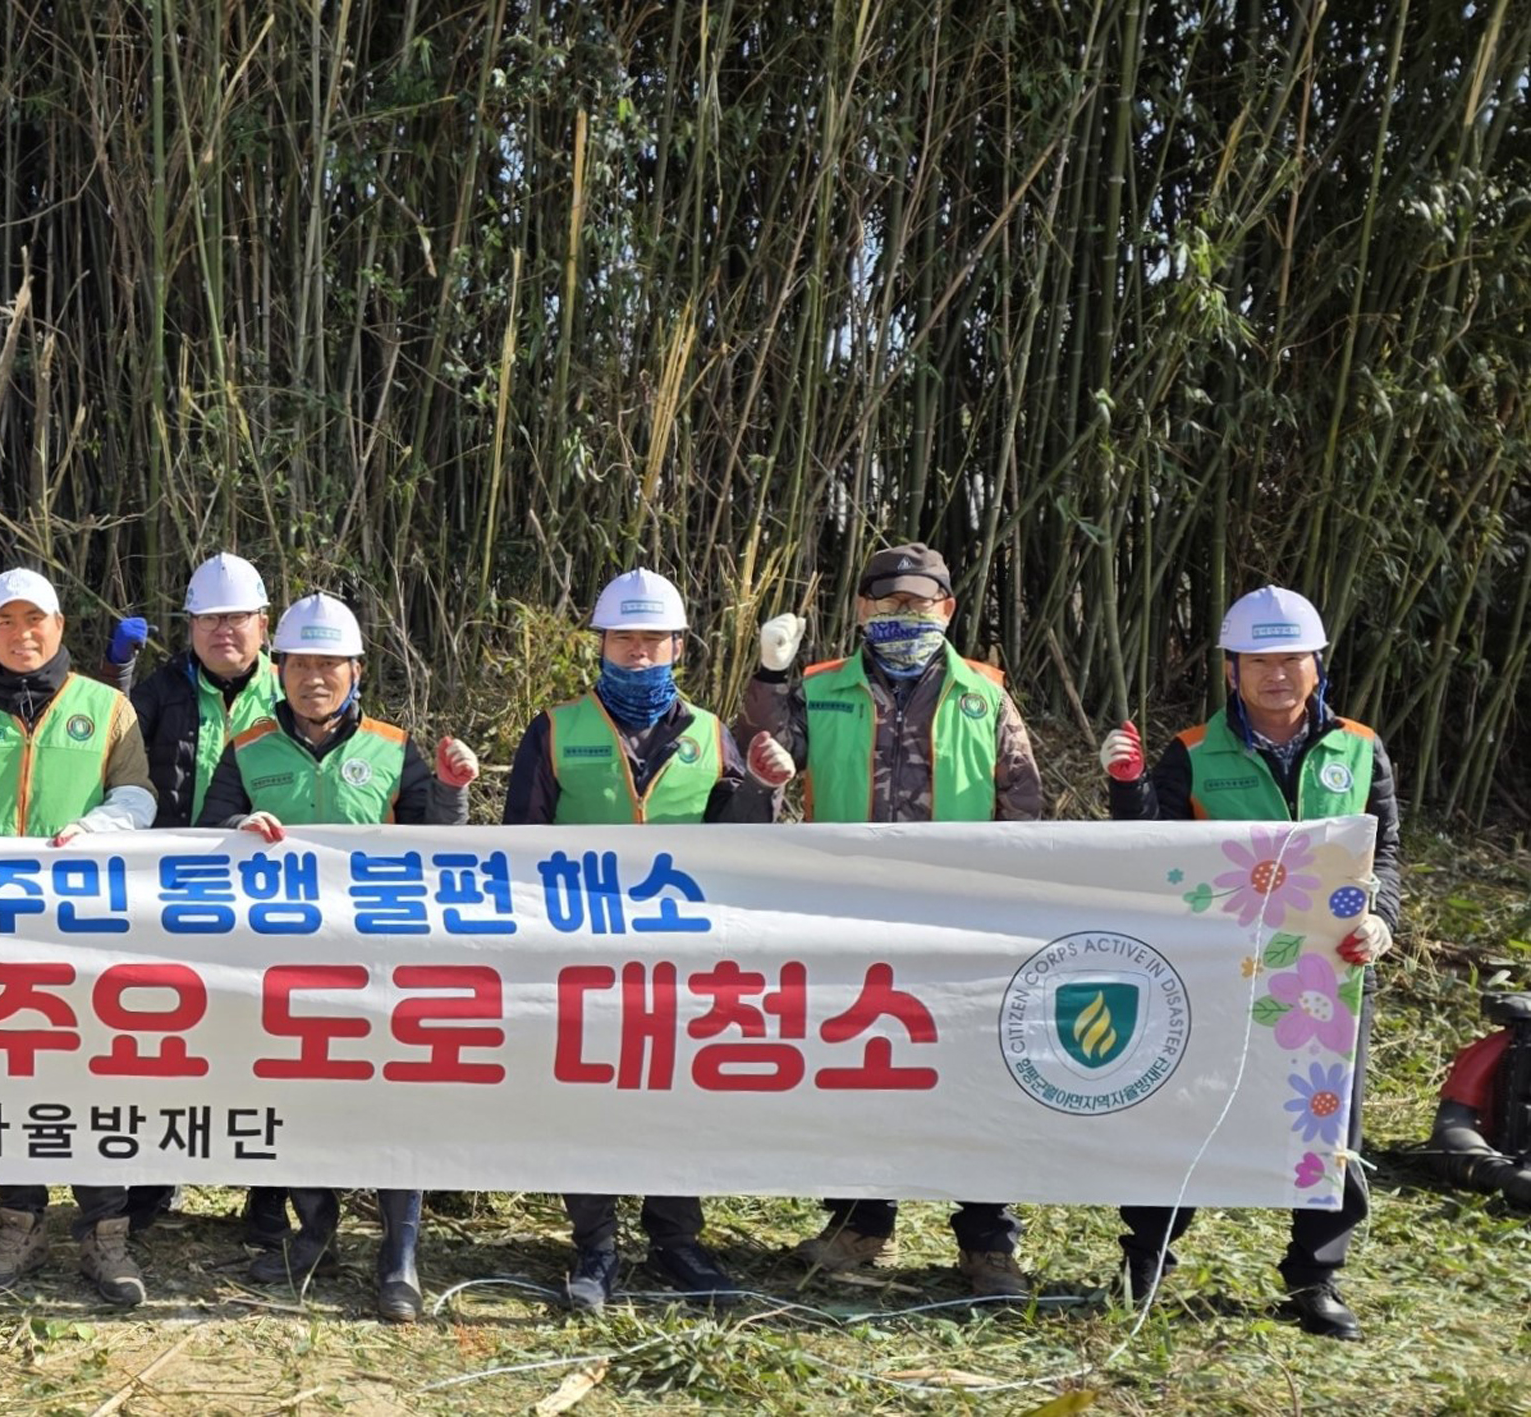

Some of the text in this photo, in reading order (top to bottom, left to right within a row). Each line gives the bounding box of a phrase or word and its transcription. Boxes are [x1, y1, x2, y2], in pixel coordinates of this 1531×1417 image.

[159, 853, 322, 935] 통행
[349, 851, 517, 935] 불편
[537, 851, 711, 934] 해소
[253, 964, 506, 1084] 도로
[554, 960, 939, 1091] 대청소
[1008, 937, 1185, 1056] CITIZEN CORPS ACTIVE IN DISASTER
